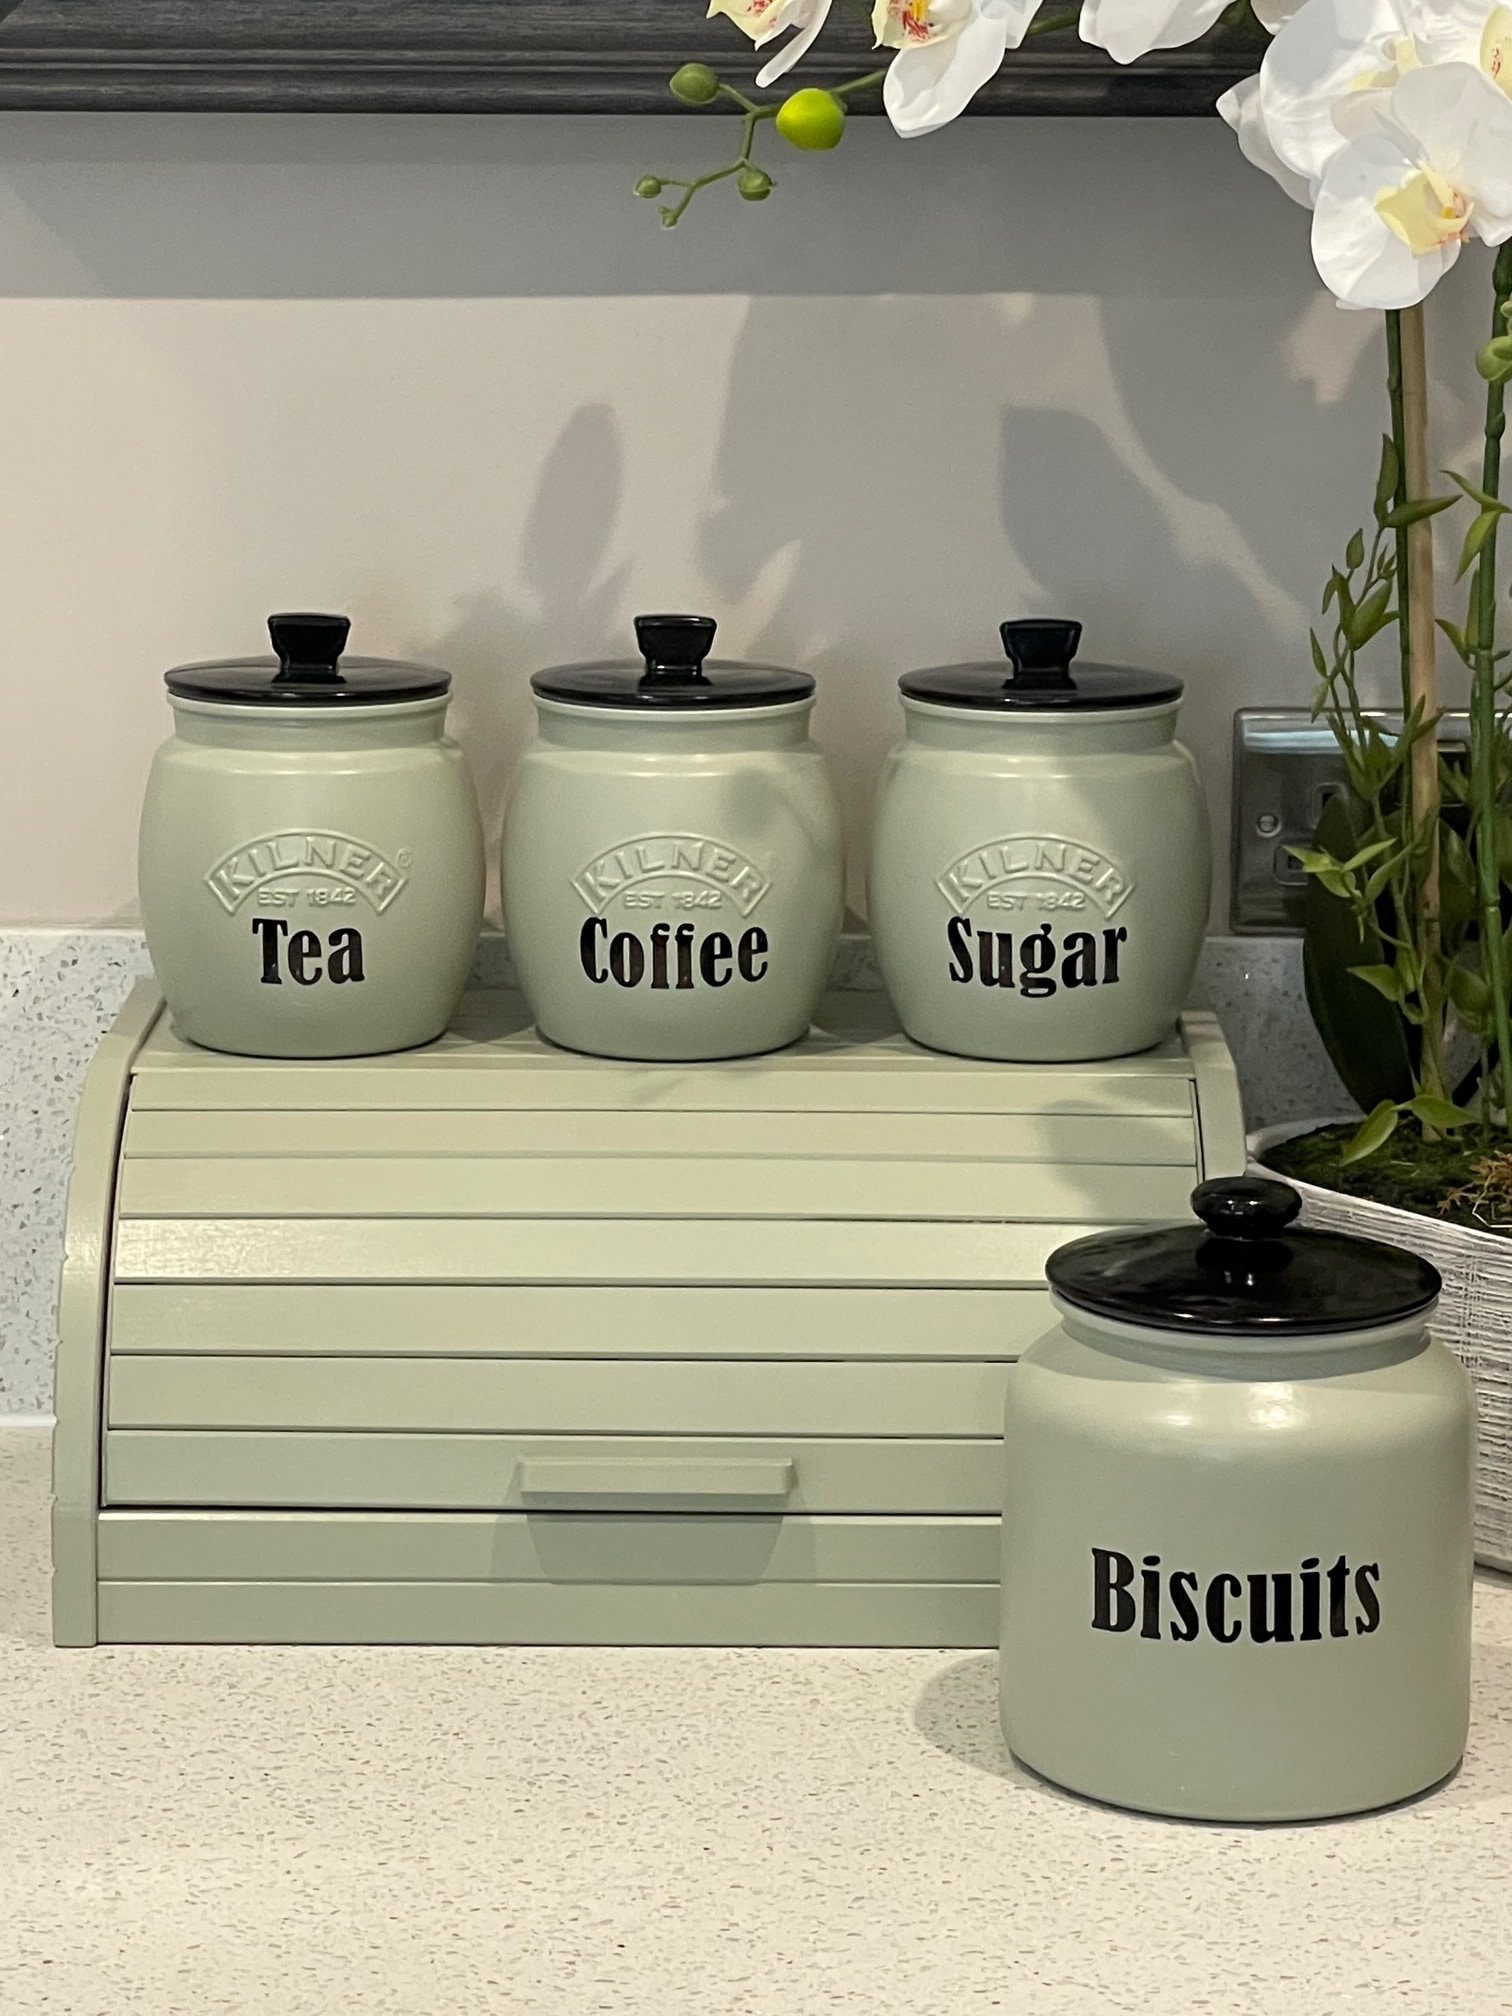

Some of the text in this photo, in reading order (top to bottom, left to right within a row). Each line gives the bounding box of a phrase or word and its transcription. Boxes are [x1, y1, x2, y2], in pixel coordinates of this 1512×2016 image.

[216, 836, 394, 901] KILNER
[257, 887, 299, 907] EST
[584, 841, 763, 902] KILNER
[624, 890, 666, 910] EST
[949, 842, 1125, 906] KILNER
[987, 890, 1028, 910] EST
[252, 918, 365, 986] Tea
[580, 916, 769, 990] Coffee
[947, 916, 1128, 998] Sugar
[1091, 1547, 1380, 1644] Biscuits
